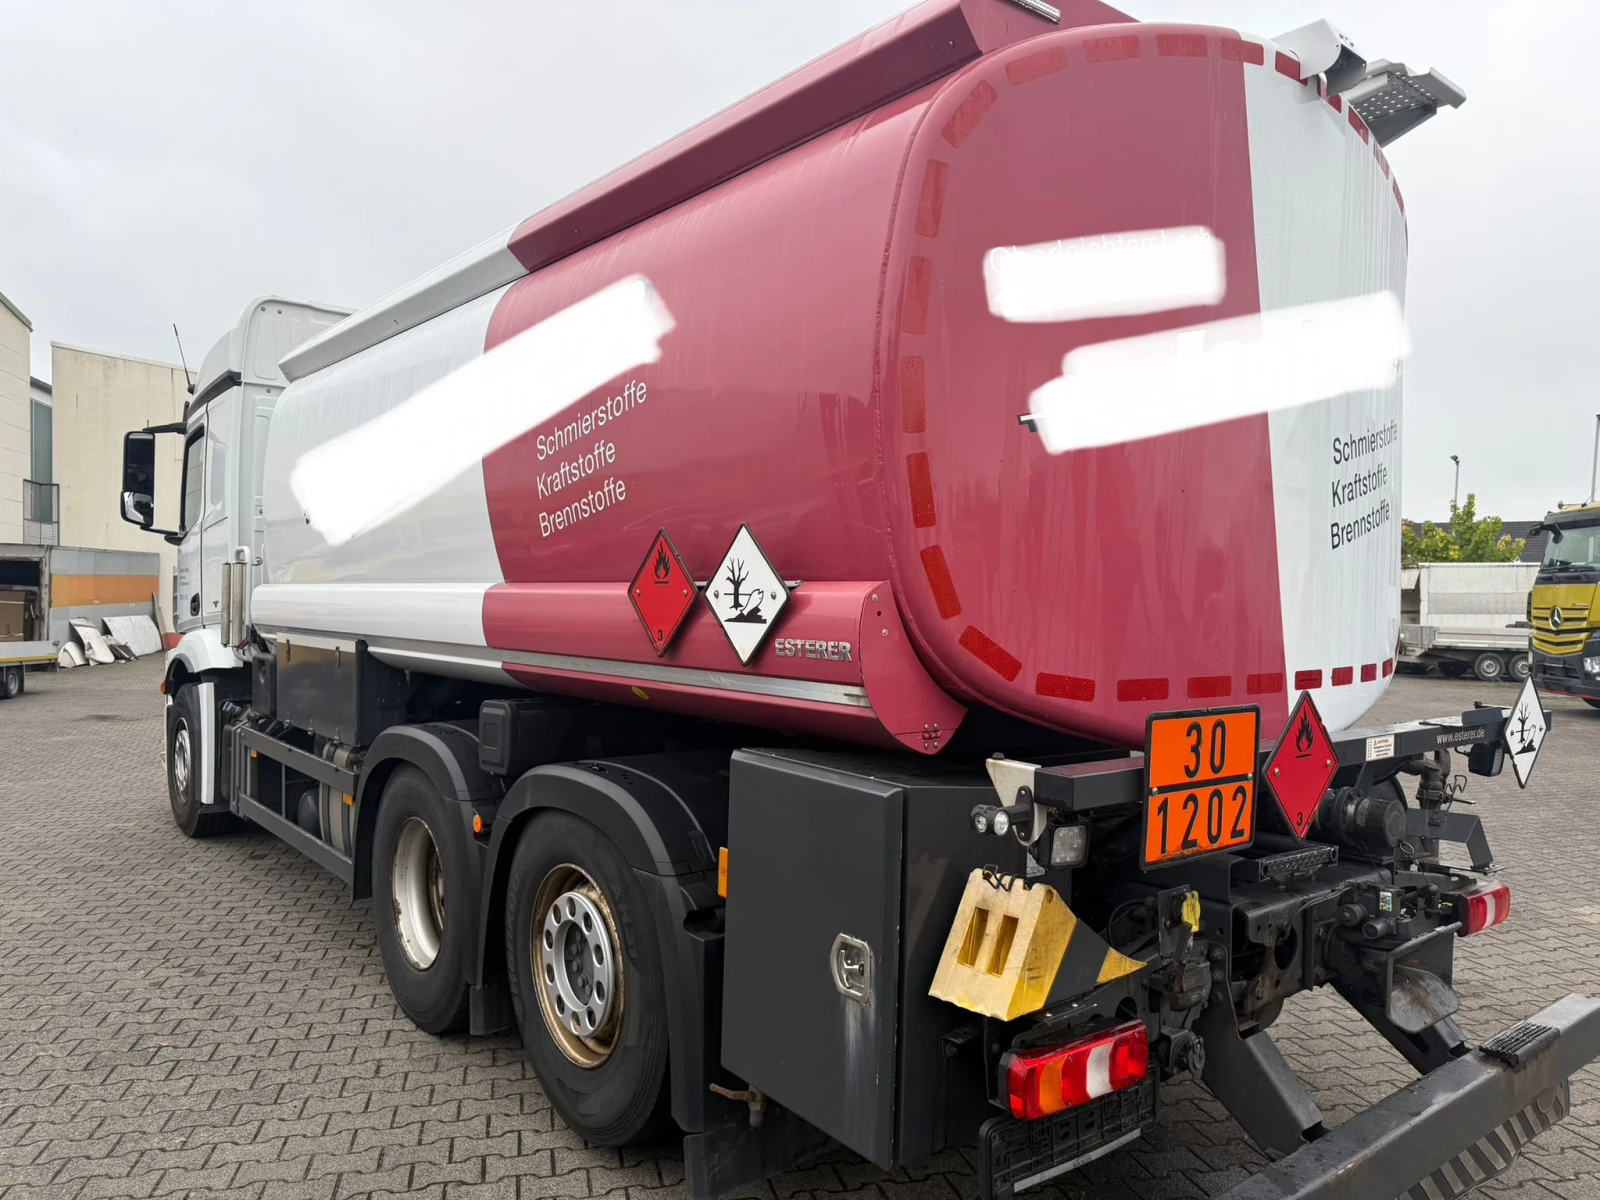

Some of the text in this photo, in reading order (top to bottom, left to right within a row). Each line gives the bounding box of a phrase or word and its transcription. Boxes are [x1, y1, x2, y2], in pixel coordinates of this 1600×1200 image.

[536, 380, 647, 461] Schmierstoffe
[1332, 419, 1397, 465] Schmierstoffe
[536, 440, 616, 499] Kraftstoffe
[1331, 462, 1387, 508] Kraftstoffe
[538, 478, 627, 538] Brennstoffe
[1330, 499, 1390, 550] Brennstoffe
[656, 630, 664, 642] 3
[774, 638, 853, 662] ESTERER
[1183, 719, 1227, 779] 30
[1436, 726, 1485, 745] www.esterer.de
[1157, 785, 1248, 855] 1202
[1296, 811, 1304, 827] 3
